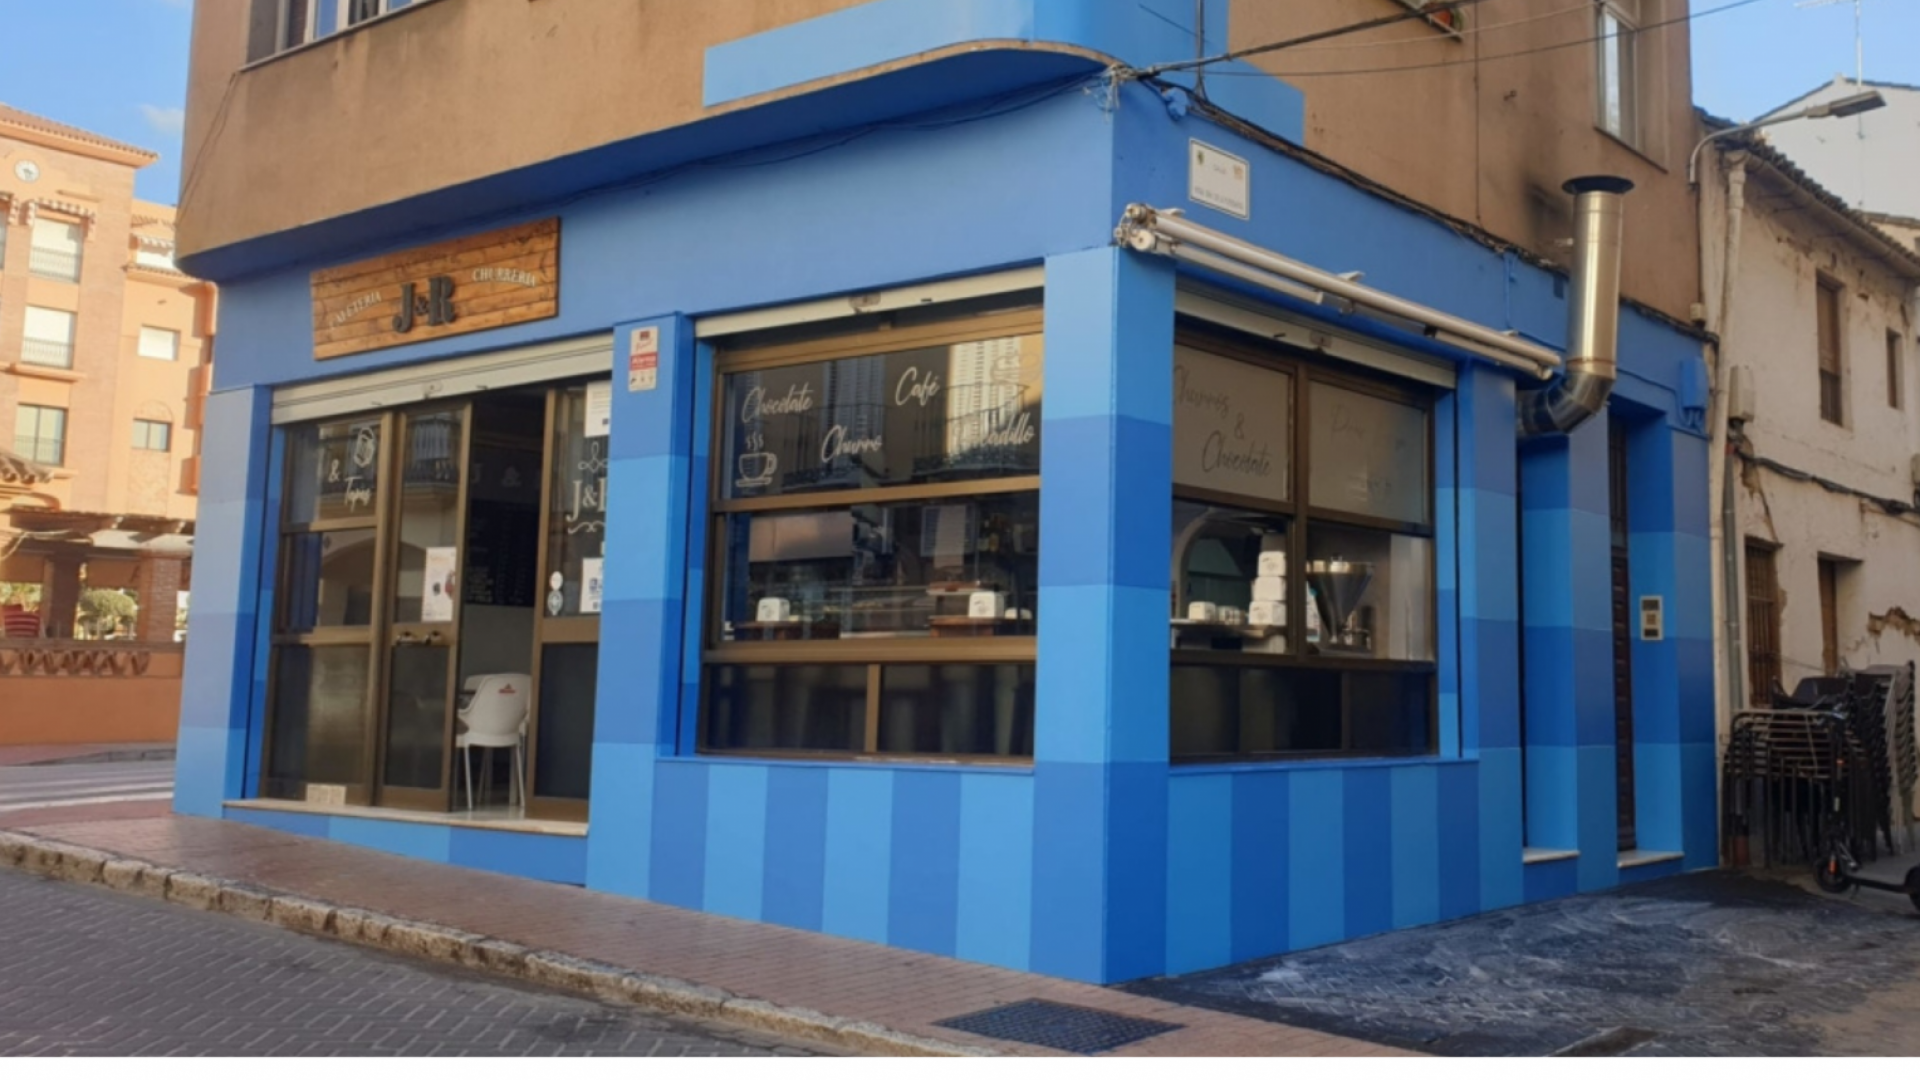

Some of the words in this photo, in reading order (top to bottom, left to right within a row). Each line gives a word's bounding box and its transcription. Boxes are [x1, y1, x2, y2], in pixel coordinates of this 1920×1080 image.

[392, 274, 456, 334] J&R
[741, 381, 813, 423] Chocolate
[895, 366, 940, 406] Café
